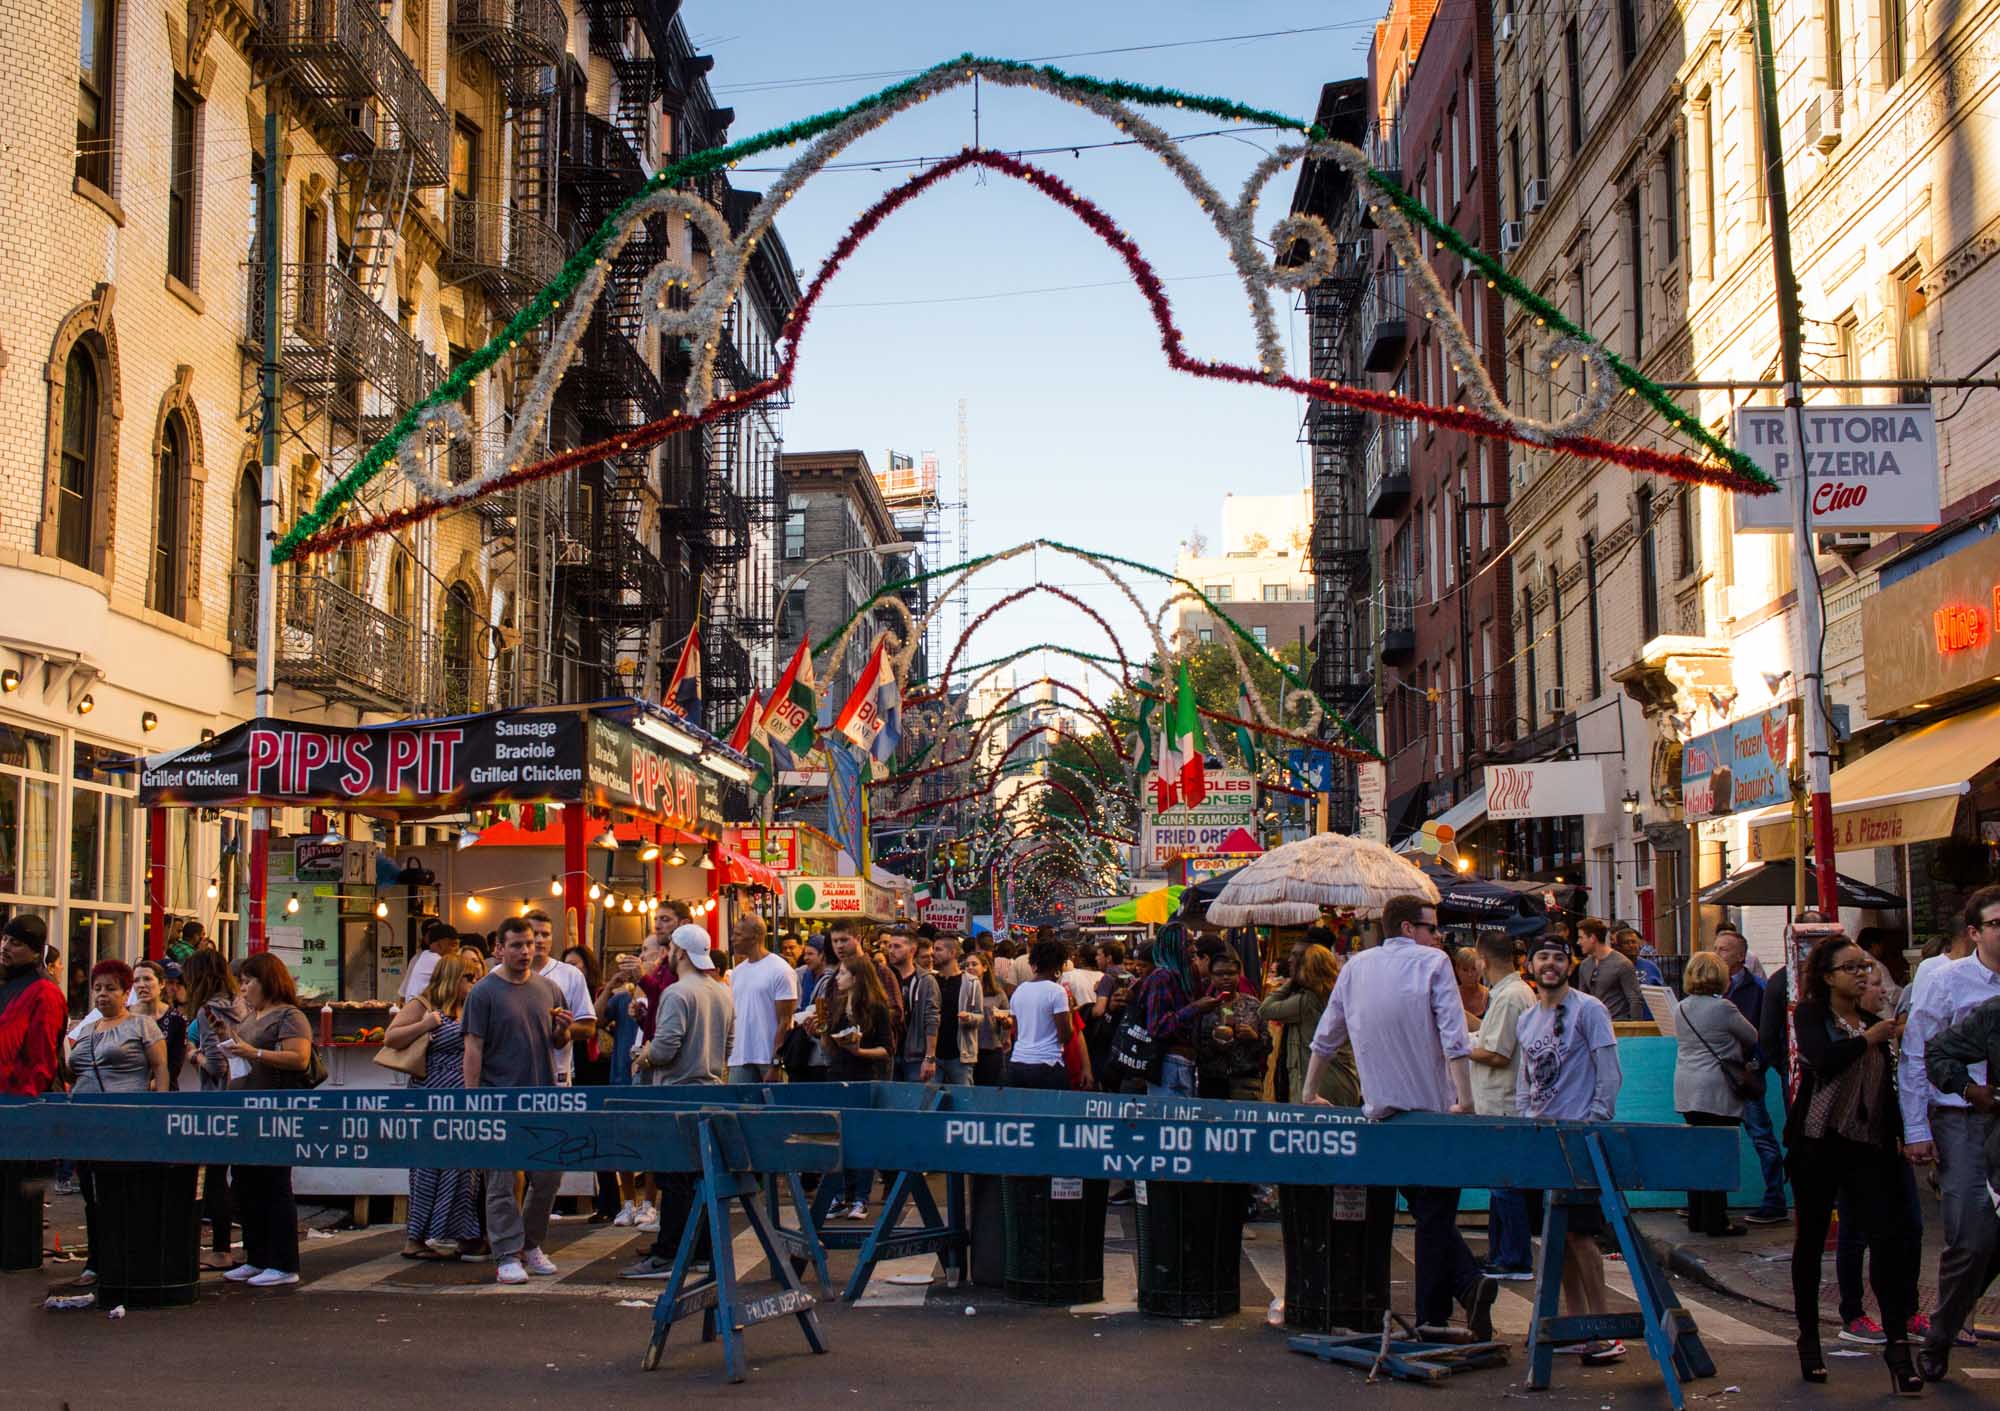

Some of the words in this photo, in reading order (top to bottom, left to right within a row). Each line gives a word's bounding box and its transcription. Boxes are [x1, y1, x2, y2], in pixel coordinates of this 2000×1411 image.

[1774, 451, 1901, 477] PZZERIA
[1812, 482, 1868, 515] Ciao
[1933, 607, 1978, 654] Wine
[776, 700, 806, 728] BIG
[857, 702, 882, 731] BIG
[495, 720, 557, 738] Sausage
[770, 718, 789, 735] ONE
[852, 722, 871, 739] ONE
[495, 742, 556, 760] Braciole
[1734, 734, 1762, 760] Frozen
[247, 729, 374, 796] PIP'S
[386, 728, 464, 794] PIT
[142, 769, 182, 787] Grilled
[186, 769, 239, 787] Chicken
[470, 767, 518, 783] Grilled
[522, 765, 582, 782] Chicken
[632, 744, 674, 817] PIP'S
[675, 763, 699, 825] PIT
[1148, 781, 1251, 791] ZOLES
[1147, 794, 1252, 806] CONES
[1158, 815, 1194, 825] GINAS
[1197, 815, 1244, 825] FAMOUS
[1859, 814, 1903, 843] Pizzeria
[1156, 829, 1196, 844] FRIED
[1200, 828, 1237, 844] ORE
[830, 899, 860, 911] SAUSAGE
[926, 914, 965, 923] SAUSAGE
[244, 1096, 321, 1109] POLICE
[343, 1096, 390, 1110] LINE
[428, 1095, 455, 1111] DO
[466, 1094, 503, 1111] NOT
[517, 1093, 587, 1112] CROSS
[1086, 1100, 1147, 1119] POLICE
[1163, 1105, 1202, 1120] LINE
[168, 1114, 239, 1137] POLICE
[259, 1116, 305, 1138] LINE
[342, 1117, 368, 1139] DO
[380, 1117, 423, 1140] NOT
[433, 1119, 507, 1141] CROSS
[946, 1120, 1035, 1147] POLICE
[1059, 1123, 1115, 1149] LINE
[1160, 1126, 1192, 1151] DO
[1205, 1127, 1257, 1152] NOT
[1270, 1129, 1357, 1156] CROSS
[296, 1143, 369, 1160] NYPD
[1103, 1155, 1192, 1173] NYPD
[746, 1297, 779, 1320] POLICE
